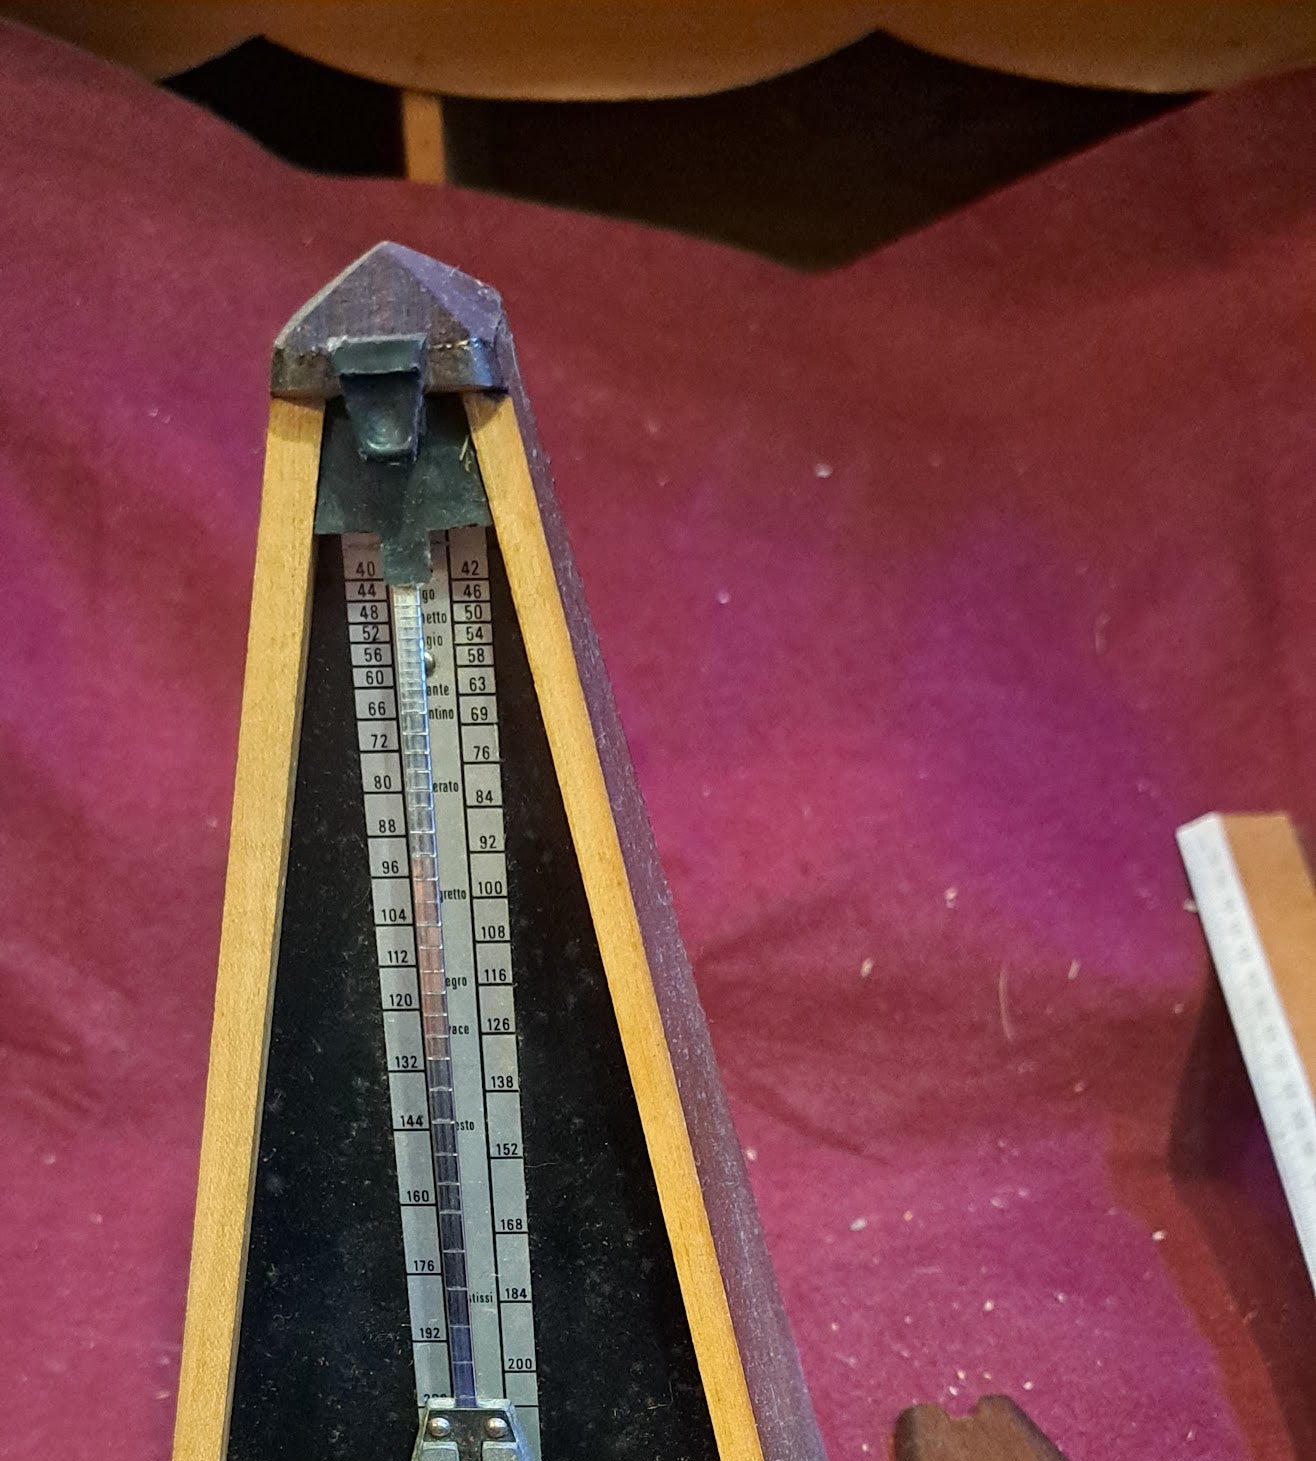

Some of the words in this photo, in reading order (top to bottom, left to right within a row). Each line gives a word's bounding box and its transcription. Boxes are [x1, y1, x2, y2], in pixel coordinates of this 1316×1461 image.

[356, 561, 375, 577] 40
[461, 560, 479, 576] 42
[358, 583, 377, 598] 44
[463, 584, 482, 599] 46
[360, 605, 379, 620] 48
[464, 604, 483, 620] 50
[362, 625, 380, 642] 52
[466, 626, 484, 642] 54
[364, 647, 383, 663] 56
[468, 648, 485, 663] 58
[365, 670, 384, 685] 60
[469, 676, 486, 692] 63
[368, 701, 386, 716] 66
[470, 706, 488, 721] 69
[371, 734, 388, 749] 72
[473, 745, 490, 760] 76
[374, 775, 392, 790] 80
[475, 790, 494, 804] 84
[378, 819, 396, 833] 88
[479, 835, 497, 849] 92
[382, 860, 399, 874] 96
[478, 881, 503, 895] 100
[381, 908, 407, 922] 104
[481, 925, 506, 939] 108
[387, 950, 408, 964] 112
[484, 969, 507, 982] 116
[389, 993, 413, 1007] 120
[487, 1018, 510, 1031] 126
[395, 1055, 418, 1069] 132
[490, 1075, 514, 1089] 138
[400, 1115, 424, 1127] 144
[496, 1143, 518, 1156] 152
[407, 1190, 430, 1202] 160
[500, 1218, 523, 1230] 168
[413, 1260, 435, 1272] 176
[505, 1288, 528, 1299] 184
[419, 1327, 441, 1339] 192
[508, 1358, 533, 1369] 200
